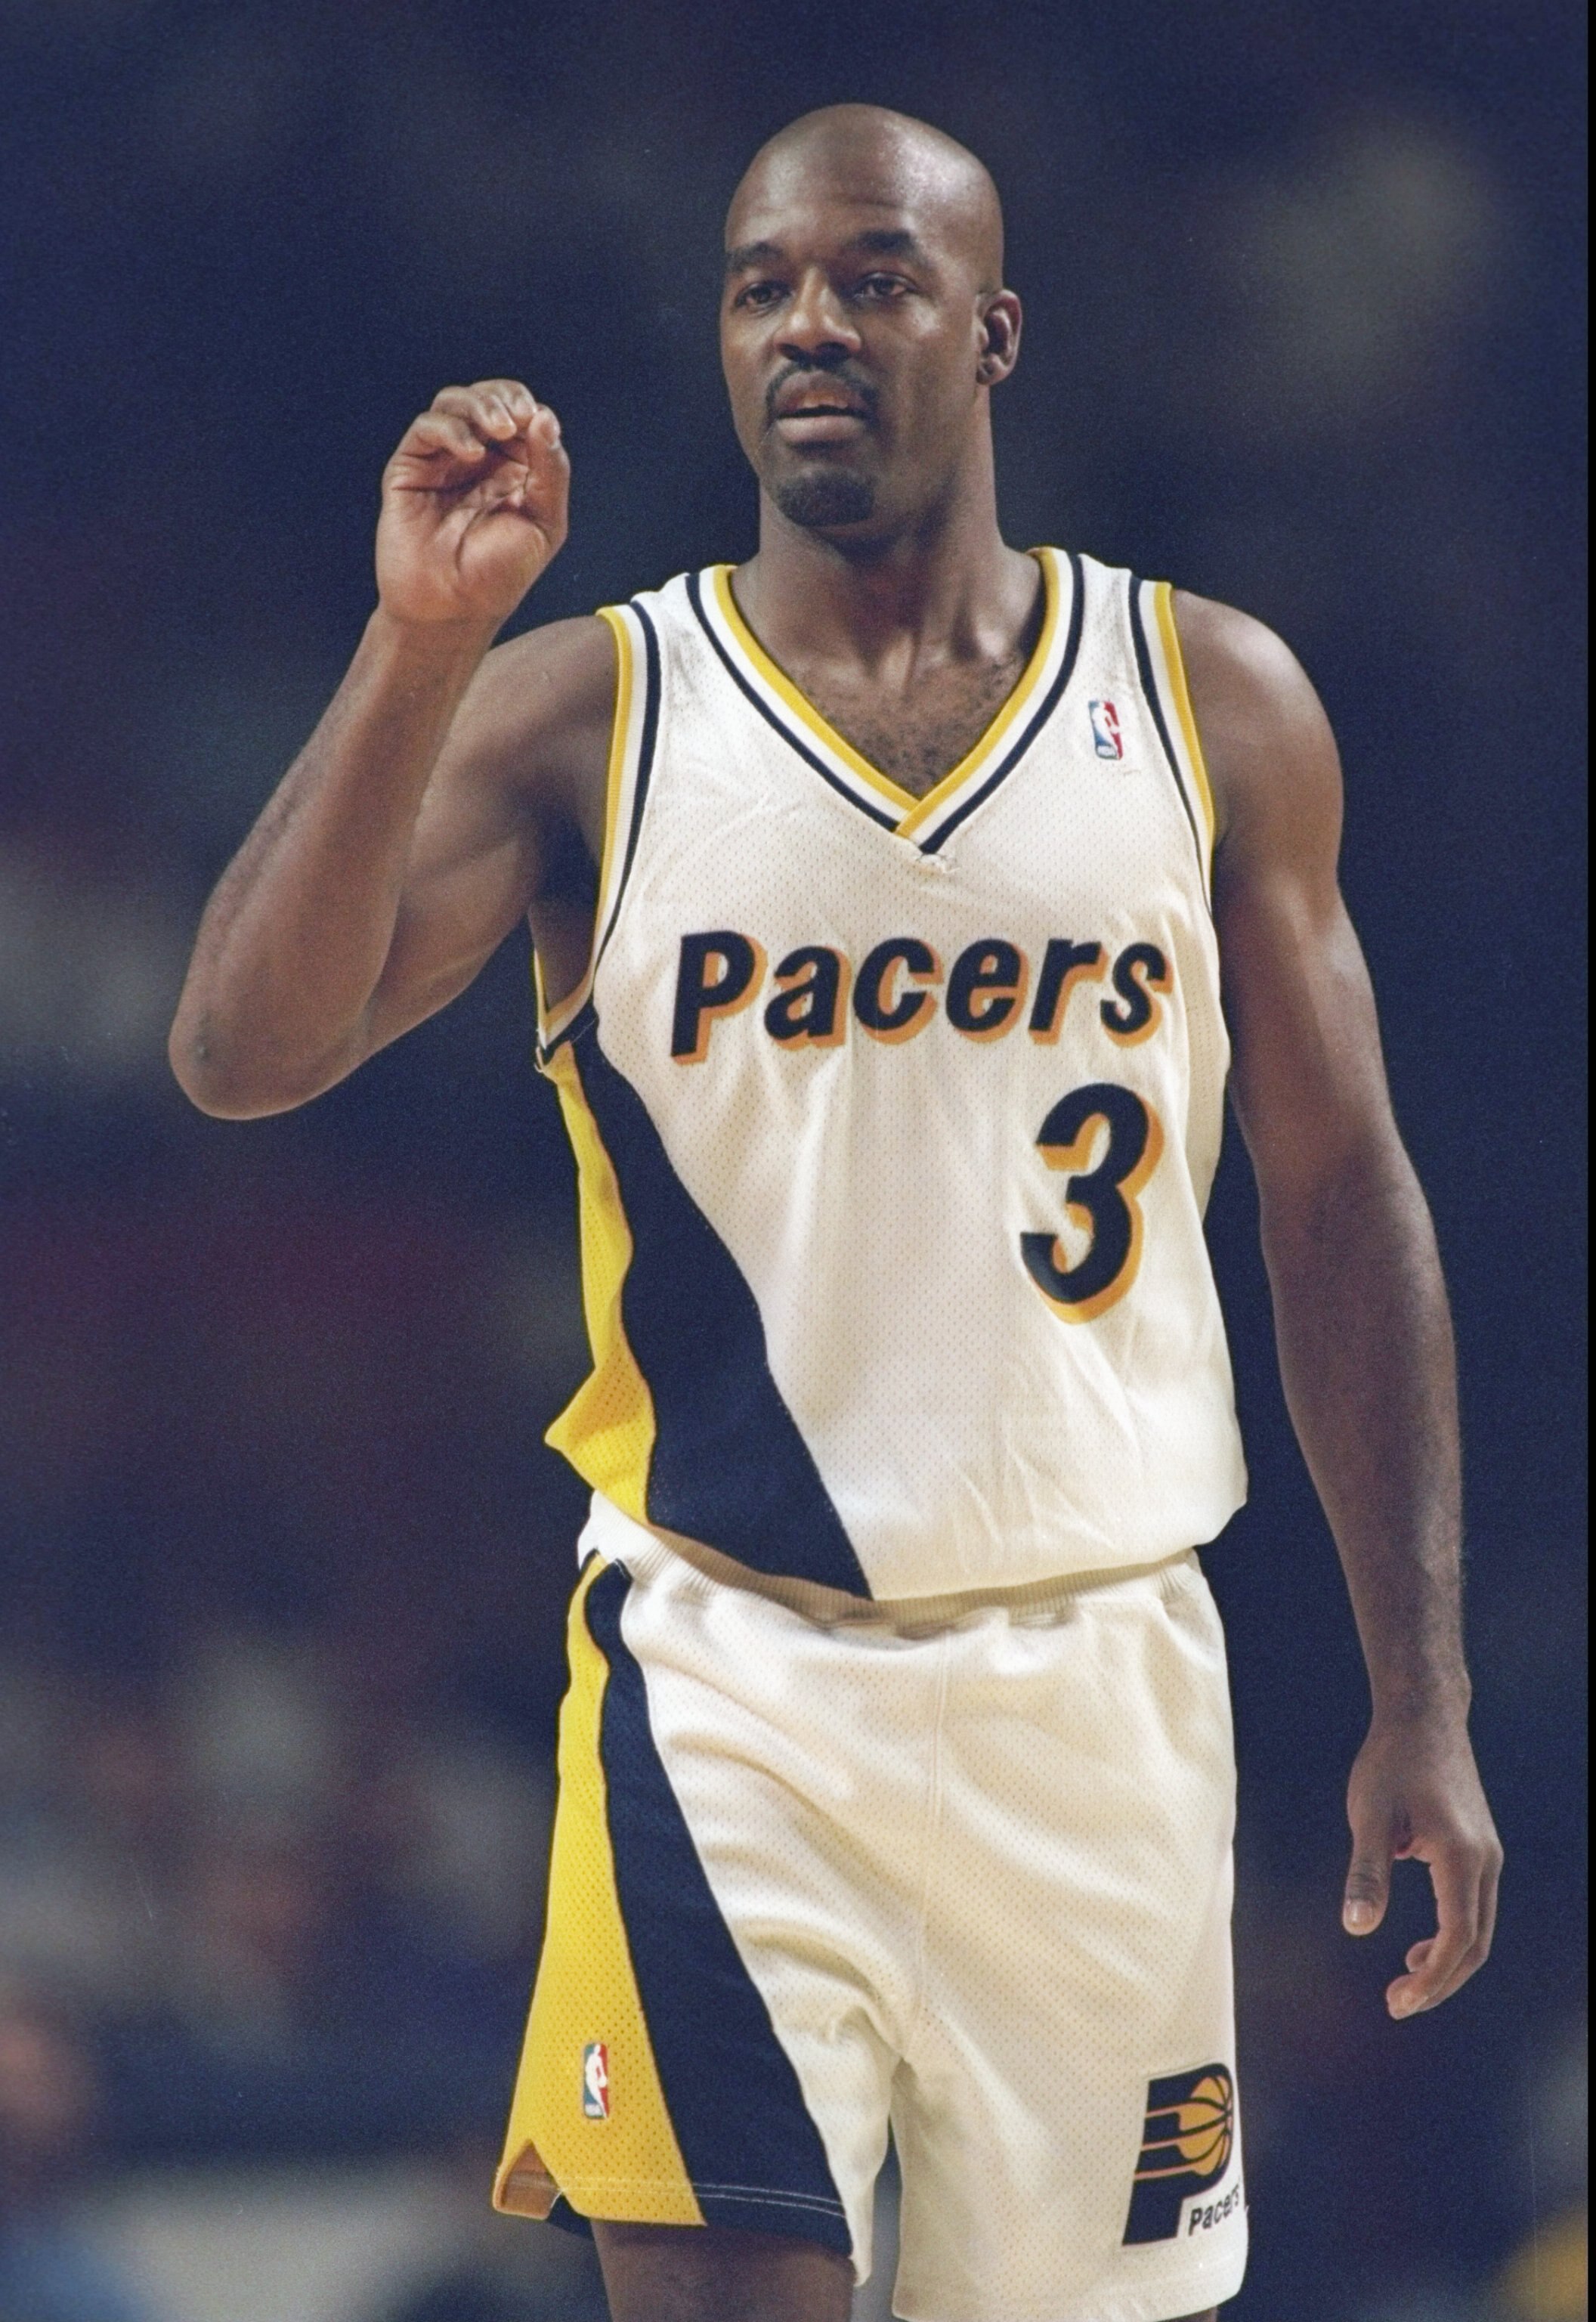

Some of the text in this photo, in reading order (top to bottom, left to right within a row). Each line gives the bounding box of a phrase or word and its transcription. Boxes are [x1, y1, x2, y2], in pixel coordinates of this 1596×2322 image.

[670, 930, 1172, 1065] Pacers
[1020, 1082, 1165, 1324] 3
[1189, 2184, 1239, 2236] Pacers
